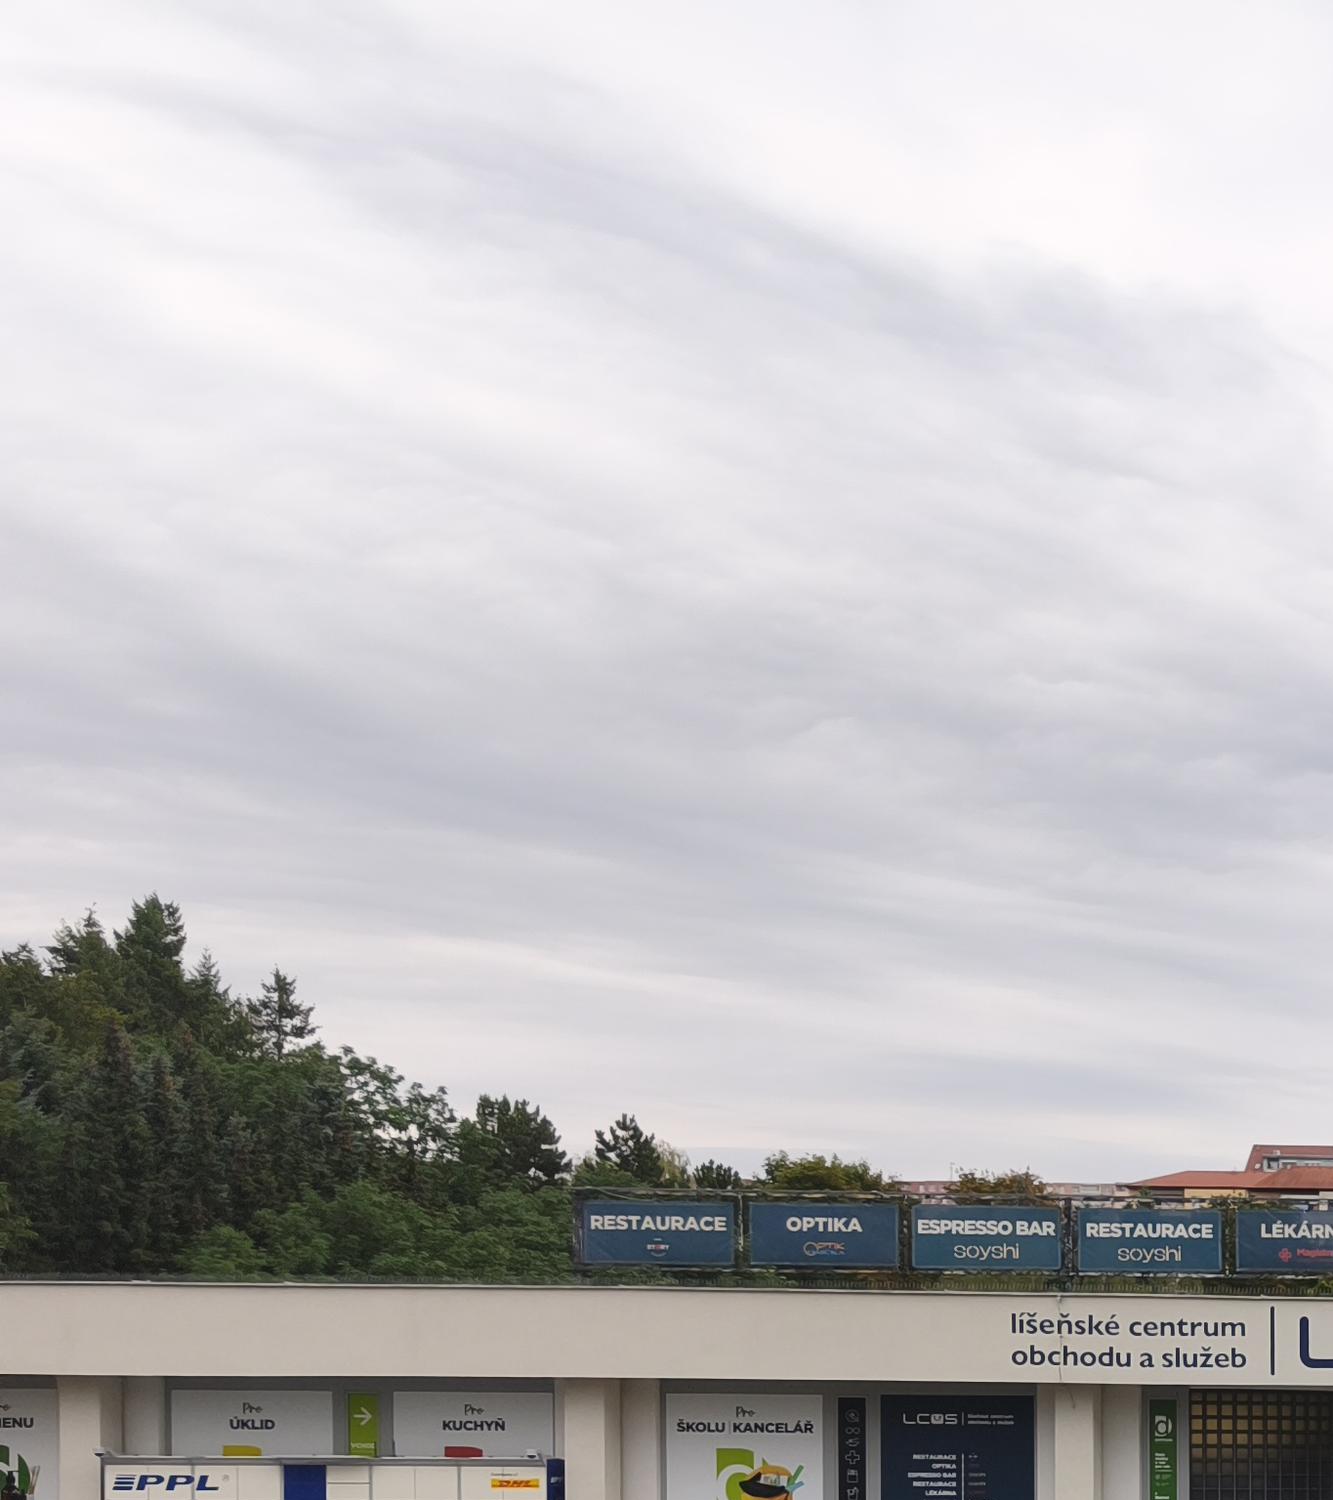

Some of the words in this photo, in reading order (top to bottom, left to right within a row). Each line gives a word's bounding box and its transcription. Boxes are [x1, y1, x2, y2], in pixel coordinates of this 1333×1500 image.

[590, 1215, 727, 1231] RESTAURACE
[786, 1216, 863, 1233] OPTIKA
[917, 1219, 1012, 1235] ESPRESSO
[1016, 1221, 1056, 1236] BAR
[1086, 1223, 1214, 1239] RESTAURACE
[953, 1243, 1019, 1260] soyshi
[1117, 1246, 1182, 1263] soyshi
[1011, 1312, 1120, 1336] líšeňské
[1129, 1318, 1246, 1337] centrum
[1011, 1345, 1131, 1368] obchodu
[1139, 1352, 1155, 1368] a
[1162, 1346, 1247, 1368] služeb
[242, 1402, 263, 1414] Pro
[464, 1404, 485, 1416] Pro
[735, 1406, 755, 1418] Pro
[0, 1417, 34, 1428] ENU
[229, 1415, 275, 1430] ÚKLID
[442, 1417, 506, 1432] KUCHYŇ
[676, 1419, 726, 1433] ŠKOLU
[732, 1420, 814, 1434] KANCELÁŘ
[136, 1474, 220, 1491] PPL
